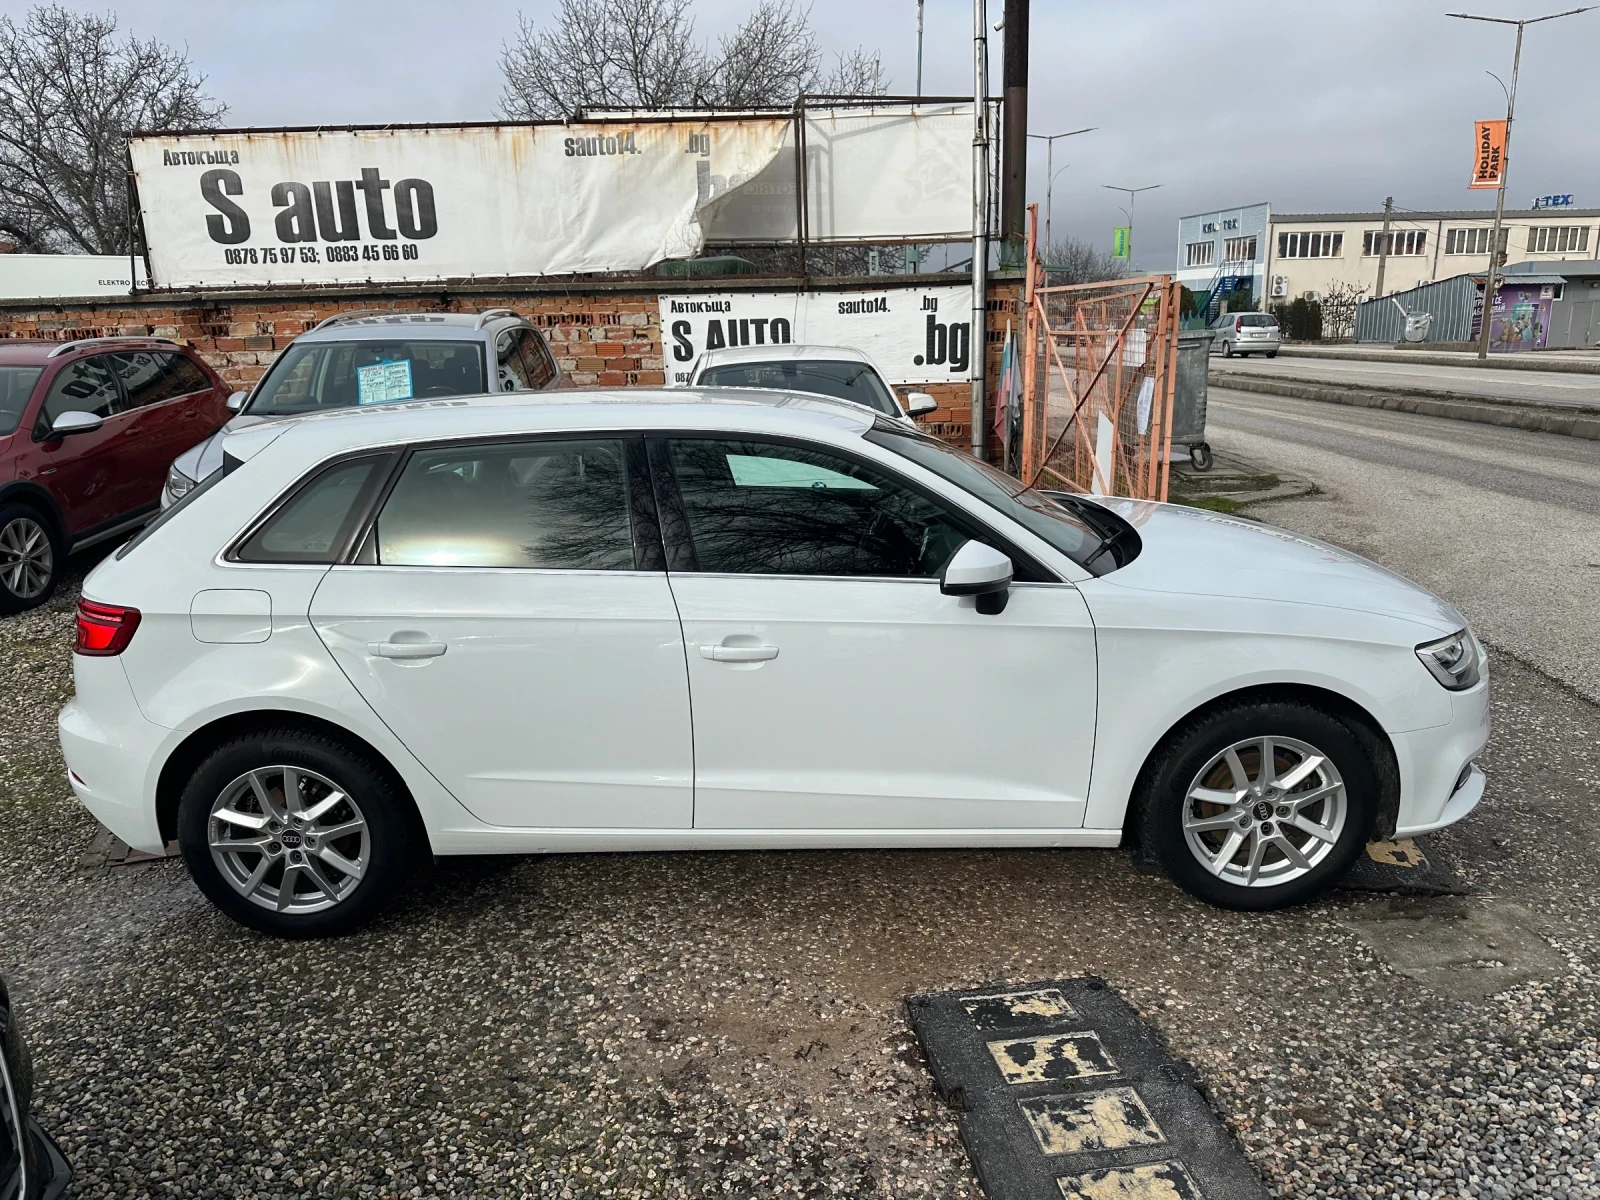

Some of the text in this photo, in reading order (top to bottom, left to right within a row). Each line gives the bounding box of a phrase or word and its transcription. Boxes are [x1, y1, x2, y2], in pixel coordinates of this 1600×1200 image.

[564, 130, 710, 157] sauto14. .bg
[1478, 125, 1491, 179] HOLIDAY
[163, 149, 239, 166] Автокъща
[1488, 145, 1500, 179] PARK
[200, 167, 438, 245] S auto
[224, 243, 419, 265] 0878 75 97 53; 0883 45 66 60
[670, 300, 731, 314] Автокъща
[838, 295, 938, 314] sauto14. .bg
[671, 318, 791, 361] S AUTO
[913, 314, 970, 373] .bg
[675, 372, 692, 383] 087
